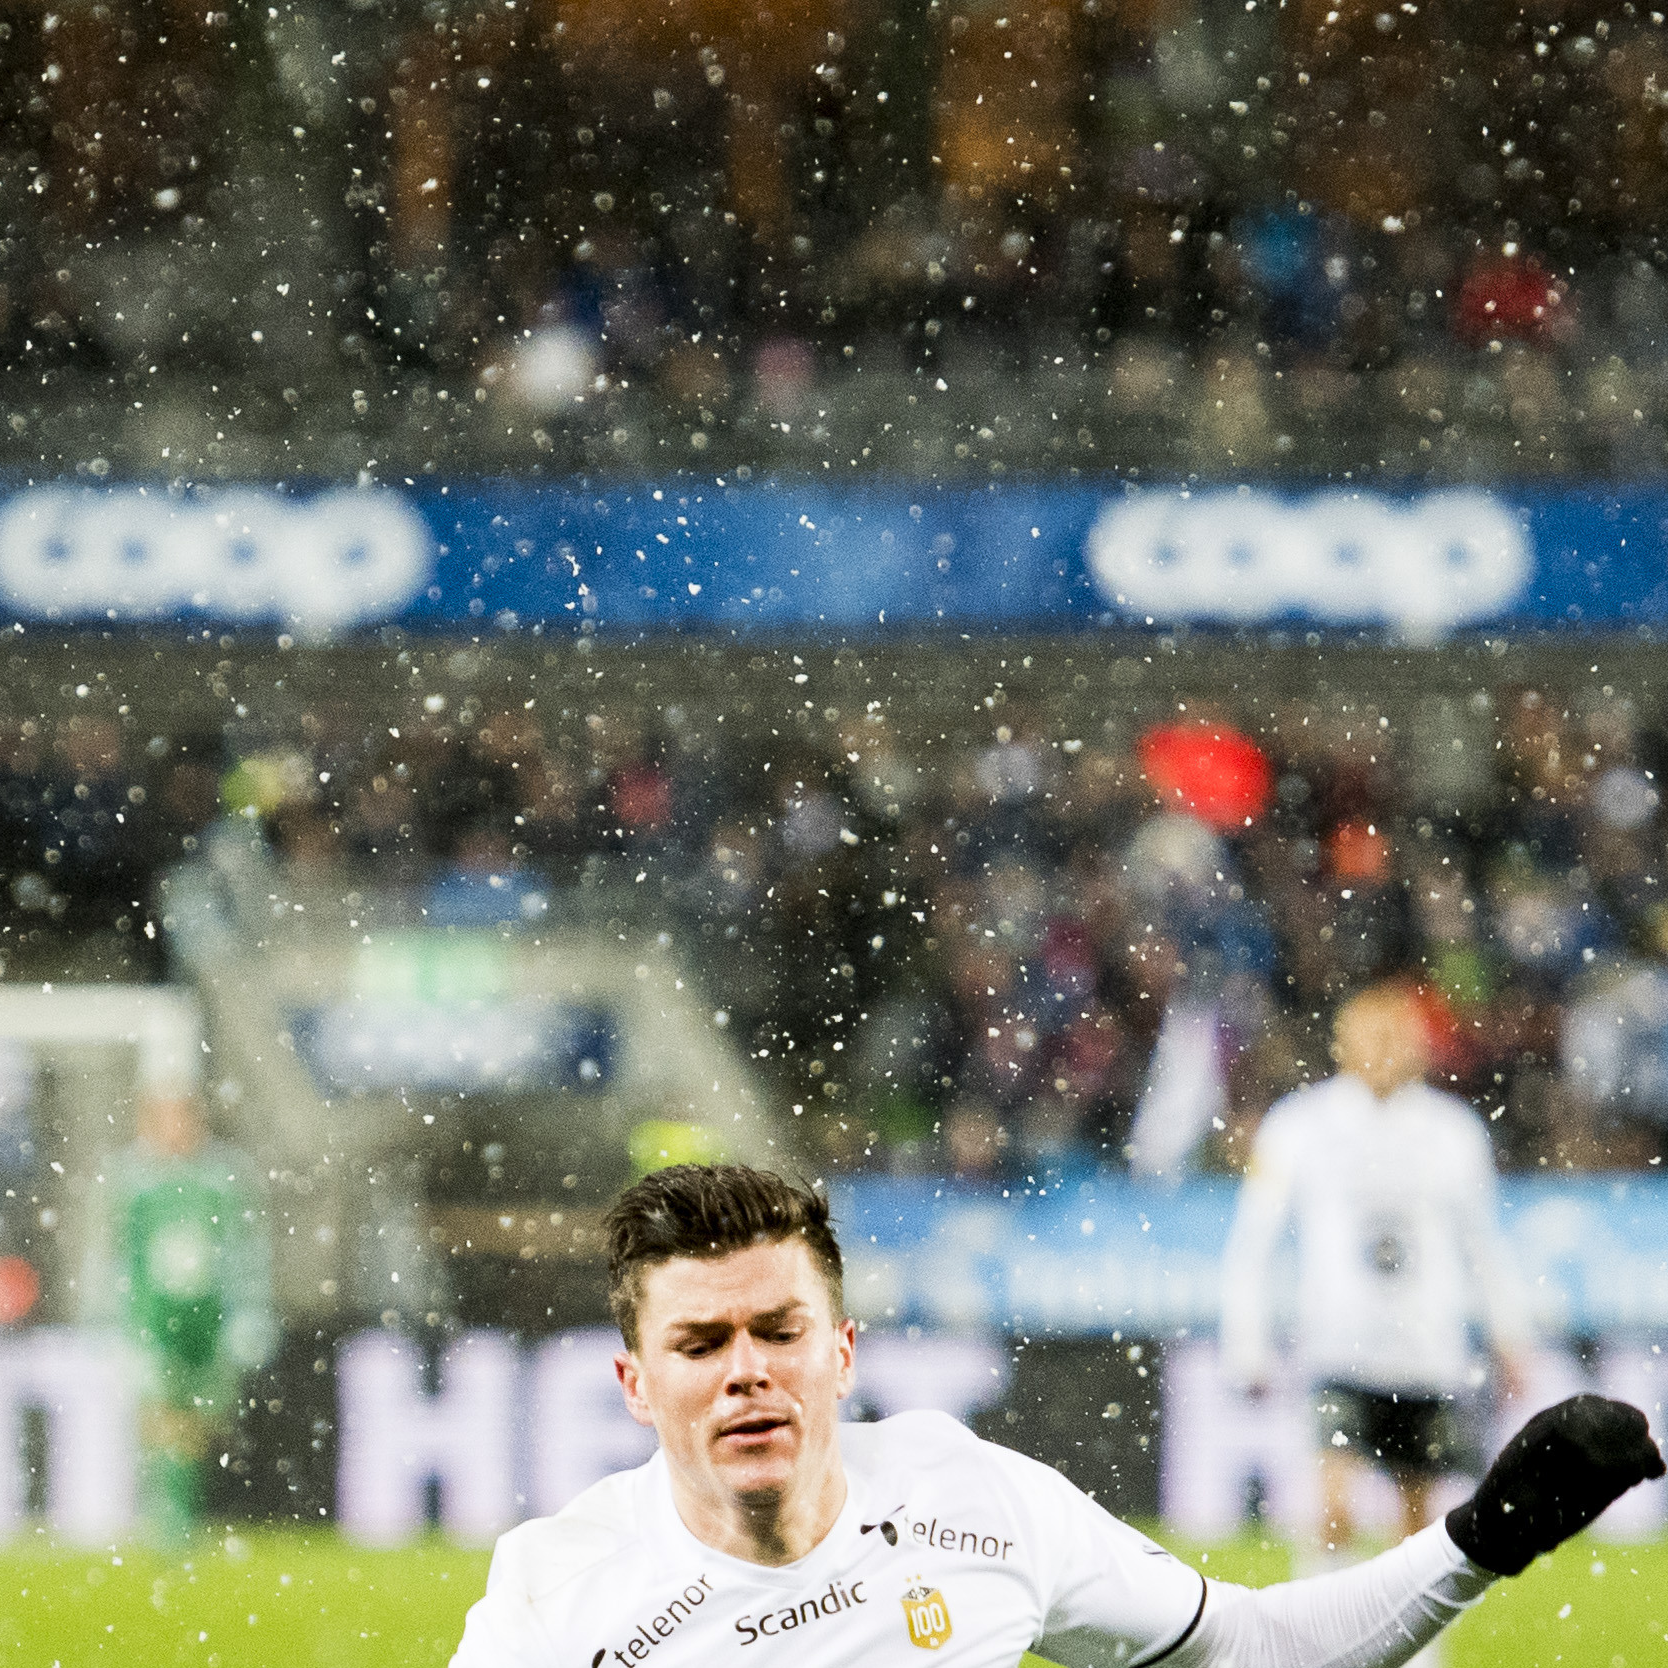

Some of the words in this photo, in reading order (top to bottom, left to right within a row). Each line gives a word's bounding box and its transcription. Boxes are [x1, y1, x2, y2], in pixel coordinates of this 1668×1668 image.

[1086, 490, 1533, 640] coop
[614, 1573, 714, 1668] telenor
[734, 1580, 868, 1646] Scandic
[910, 1602, 947, 1639] 100
